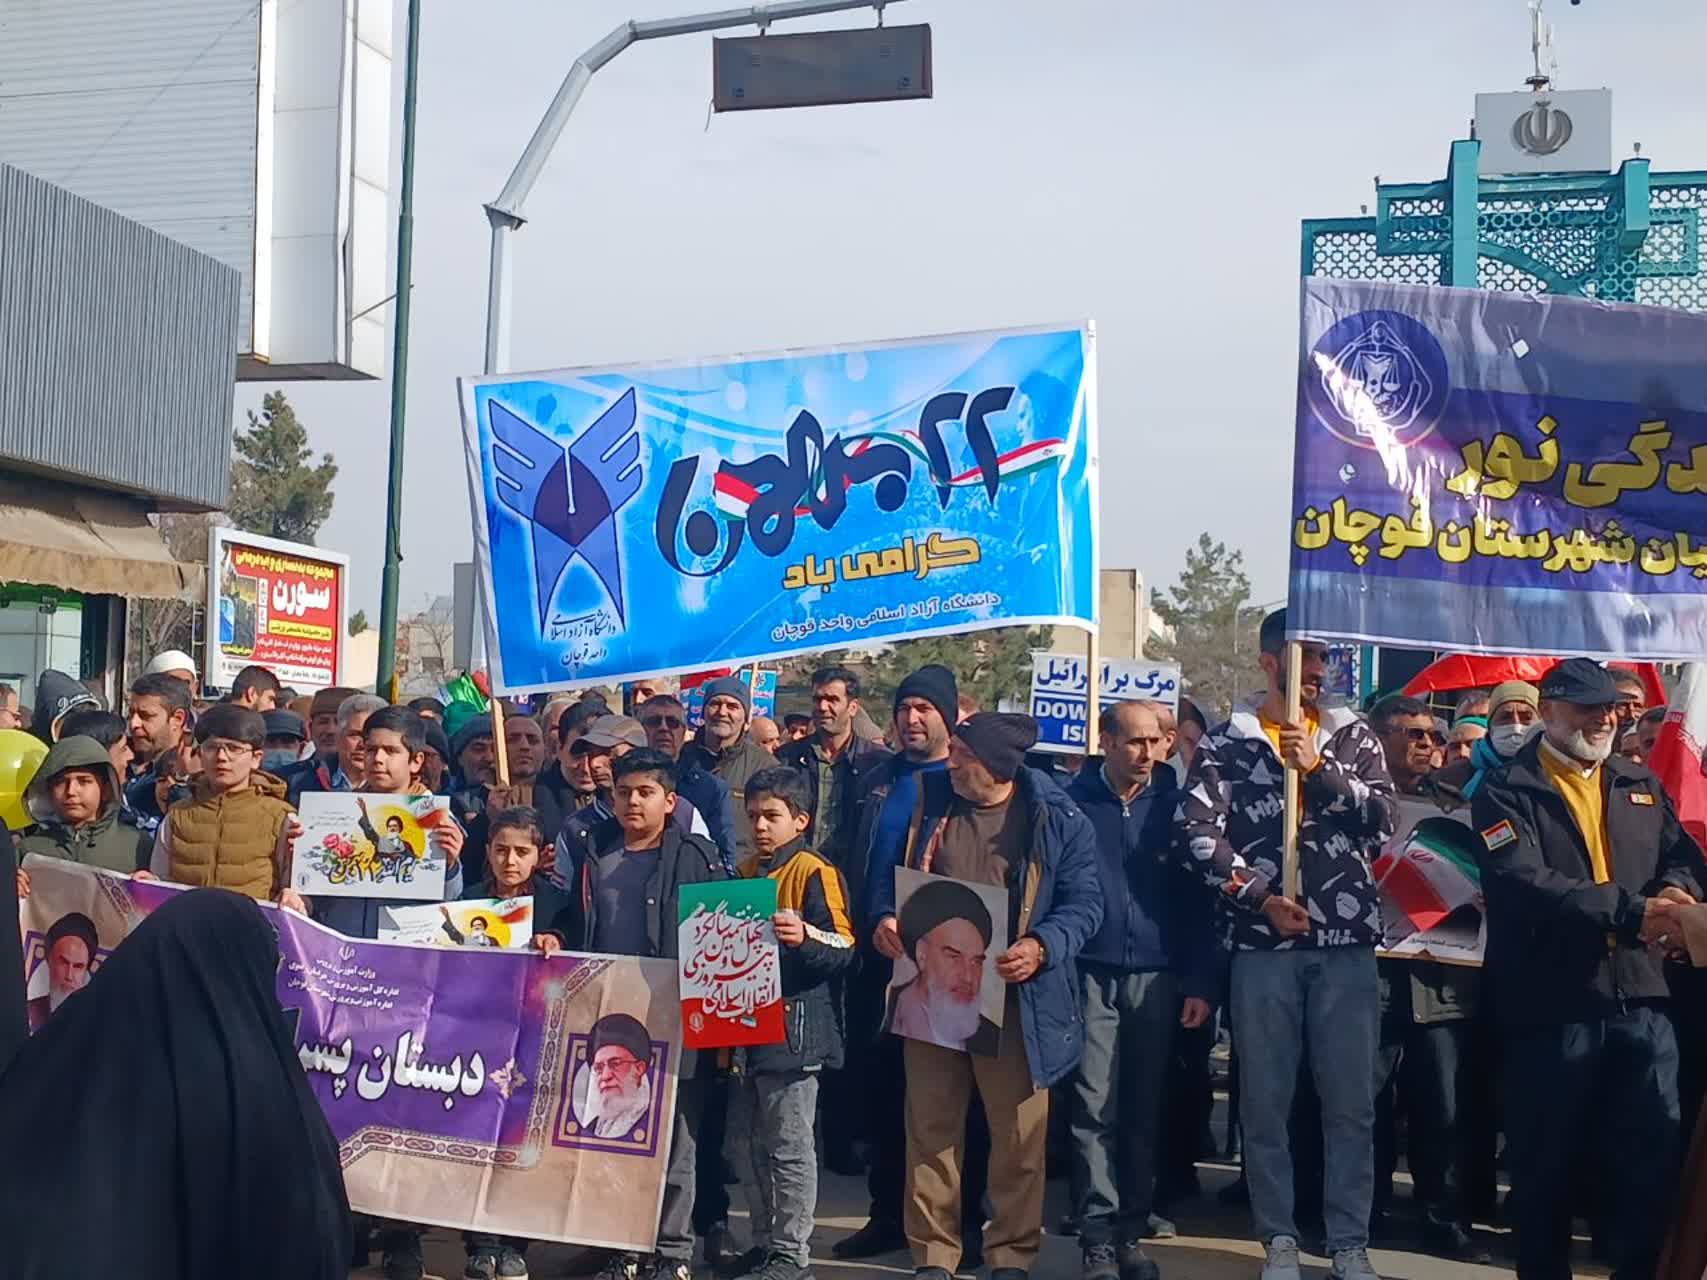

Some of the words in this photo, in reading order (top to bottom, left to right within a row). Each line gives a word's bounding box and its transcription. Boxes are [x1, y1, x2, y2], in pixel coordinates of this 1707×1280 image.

[919, 386, 1015, 512] ۲۲
[1445, 415, 1560, 499] نور
[1562, 420, 1707, 507] دگی
[655, 409, 911, 577] بهمن
[1294, 491, 1434, 566] قوچان
[1436, 511, 1636, 573] شهرستان
[782, 554, 837, 593] باد
[272, 579, 331, 617] سورن
[910, 598, 940, 617] آزاد
[942, 593, 1000, 613] دانشگاه
[588, 609, 616, 636] دانشگاه
[771, 619, 816, 643] قوچان
[821, 613, 854, 633] واحد
[857, 606, 905, 629] اسلامی
[561, 642, 589, 669] قوچان
[1036, 658, 1110, 690] ارائیل
[1108, 672, 1130, 693] بر
[1133, 669, 1176, 697] مرگ
[693, 899, 732, 946] سالگرد
[683, 949, 775, 988] پیروزی
[702, 981, 746, 1015] اسلامی
[716, 976, 776, 1023] انقلاب
[356, 1029, 486, 1110] دبستان
